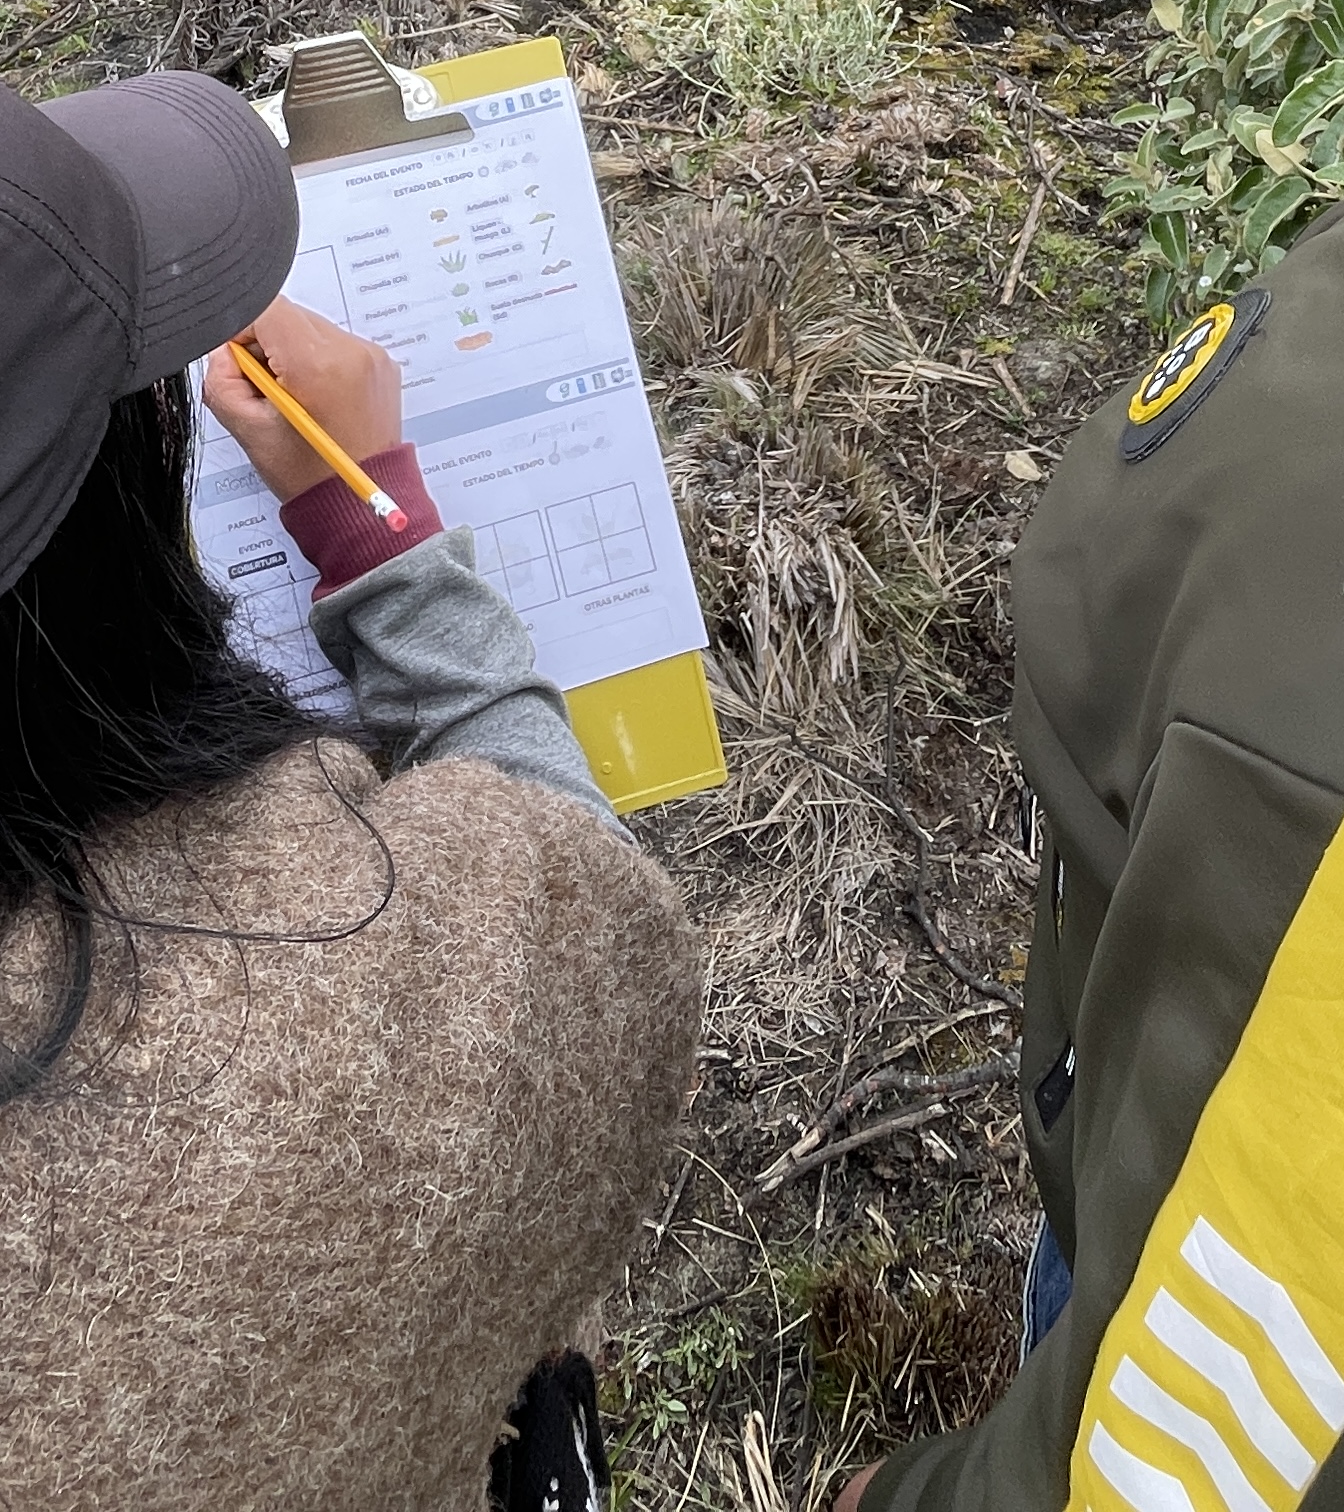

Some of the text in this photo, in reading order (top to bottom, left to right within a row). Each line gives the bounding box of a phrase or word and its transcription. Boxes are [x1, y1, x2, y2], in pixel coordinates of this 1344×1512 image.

[345, 161, 423, 187] FECHA DEL EVENTO
[394, 171, 474, 197] ESTADO DEL TIEMPO
[422, 449, 492, 476] CHA DEL EVENTO
[462, 457, 545, 488] ESTADO DEL TIEMPO
[227, 514, 267, 532] PARCELA
[238, 538, 274, 555] EVENTO
[230, 554, 285, 576] COBERTURA
[583, 585, 650, 612] OTRAS PLANTAS
